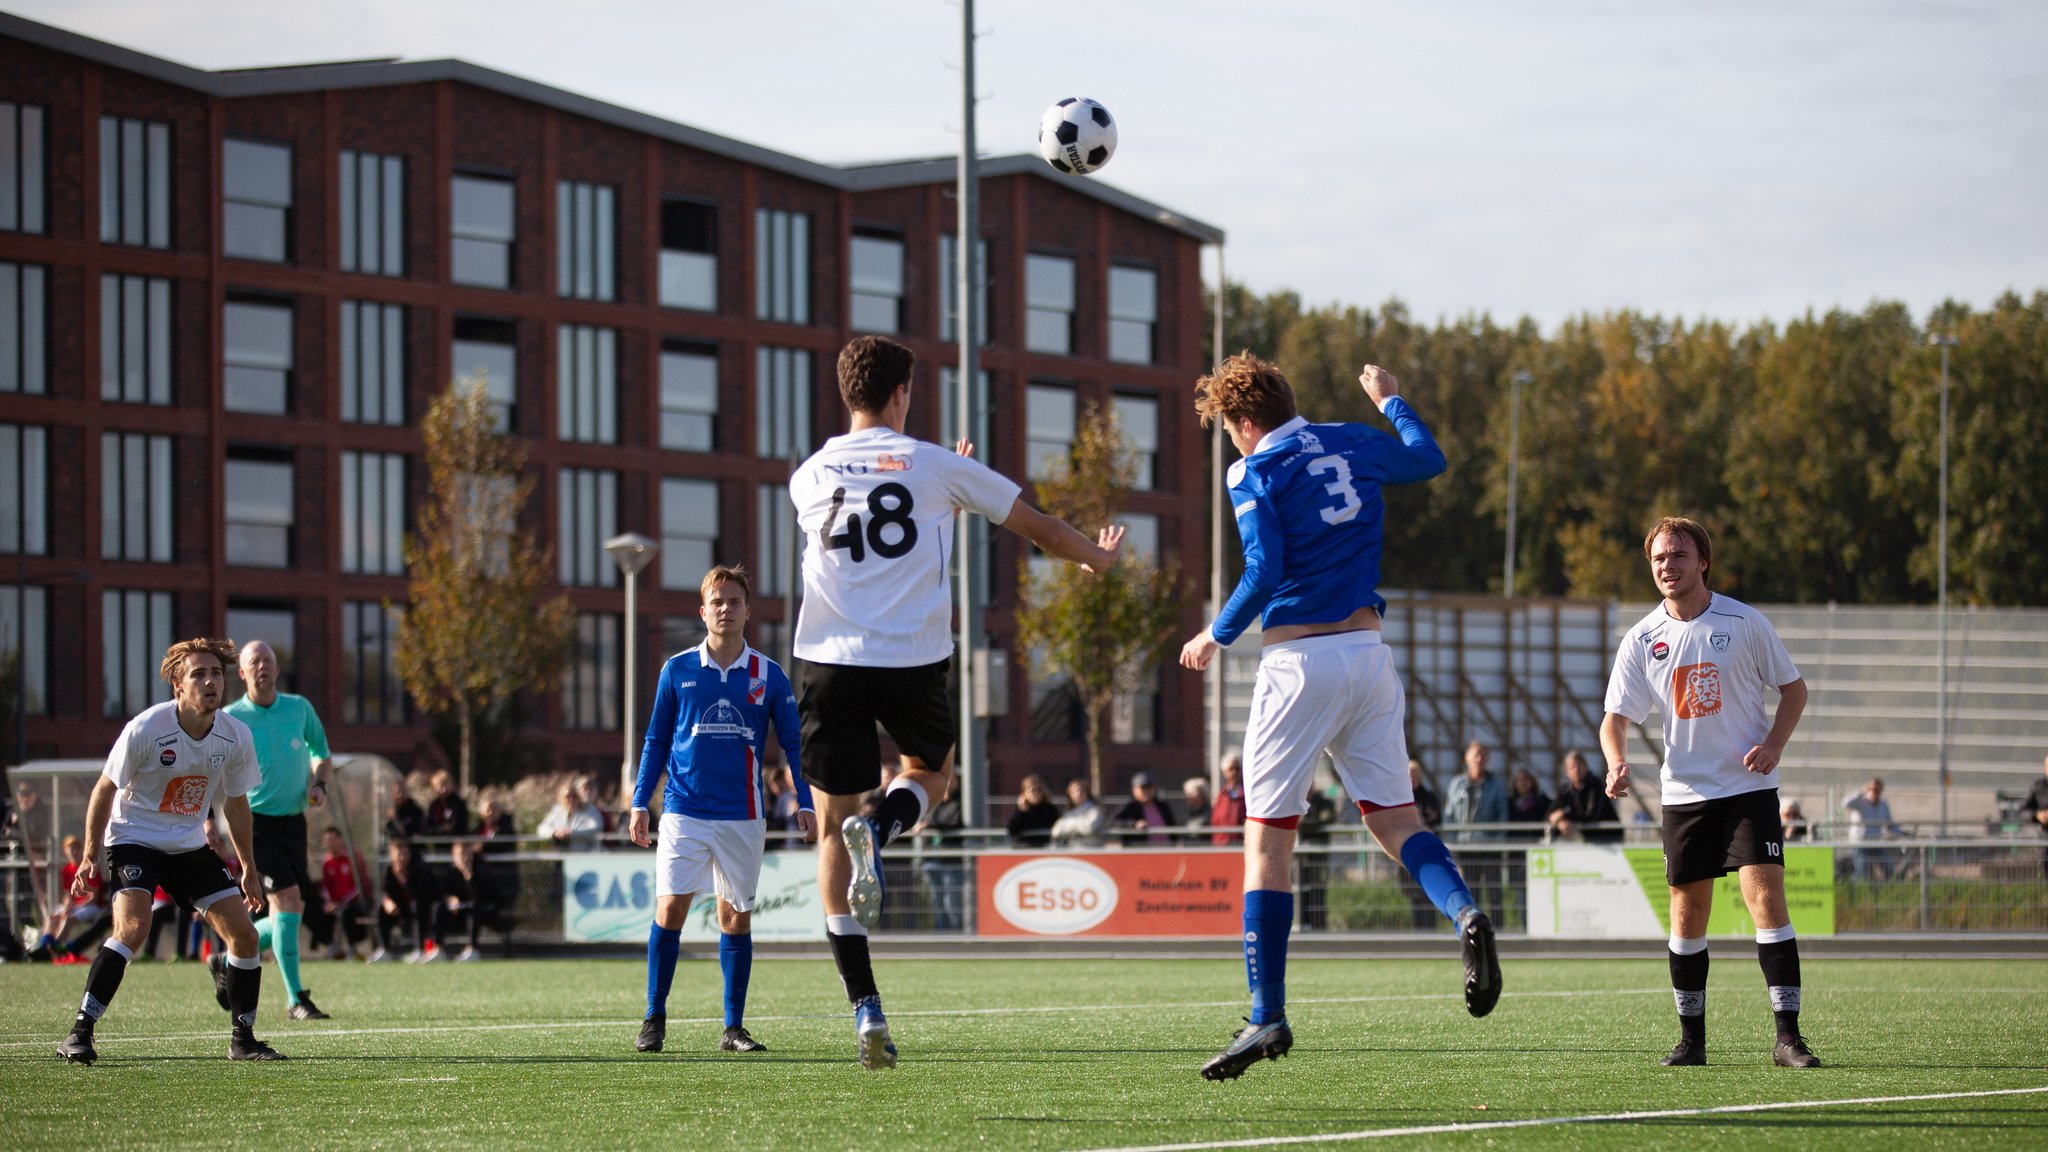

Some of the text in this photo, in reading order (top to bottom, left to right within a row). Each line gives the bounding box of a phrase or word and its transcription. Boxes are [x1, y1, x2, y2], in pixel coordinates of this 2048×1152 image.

[812, 460, 868, 485] ING
[1305, 454, 1363, 526] 3
[820, 482, 918, 563] 48
[1765, 841, 1780, 857] 10
[574, 871, 651, 909] CAS
[1017, 882, 1098, 911] Esso
